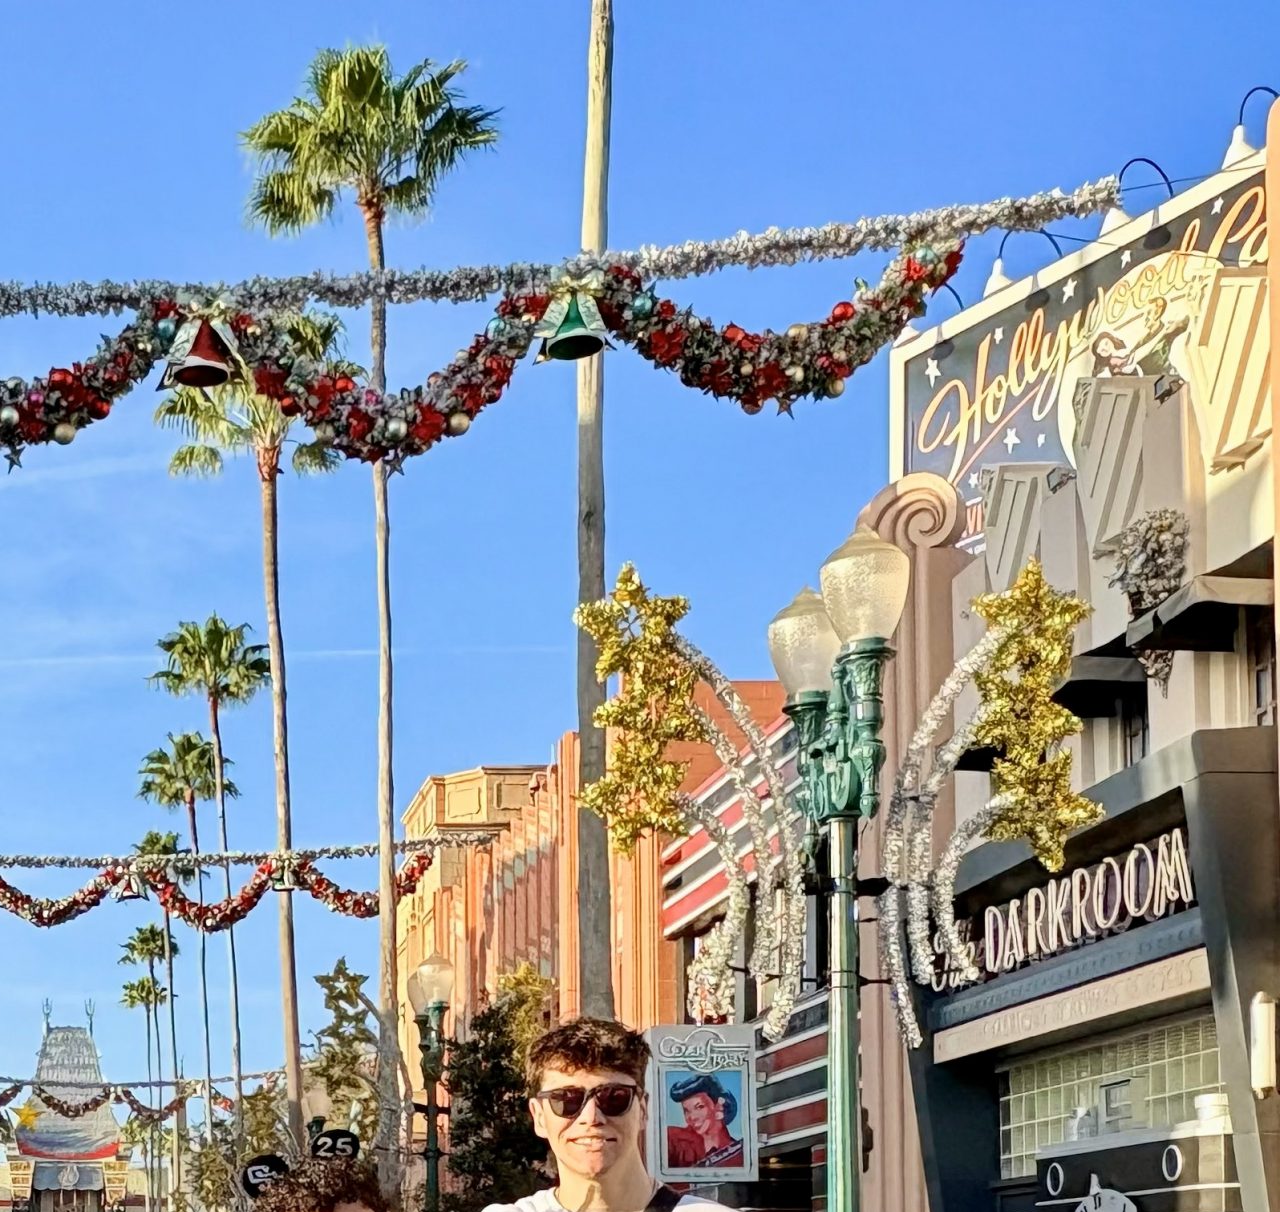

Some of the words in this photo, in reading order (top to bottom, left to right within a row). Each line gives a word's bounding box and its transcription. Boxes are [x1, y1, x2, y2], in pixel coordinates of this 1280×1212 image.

[918, 219, 1191, 482] Hollywood
[984, 828, 1193, 973] DARKROOM
[316, 1136, 353, 1157] 25
